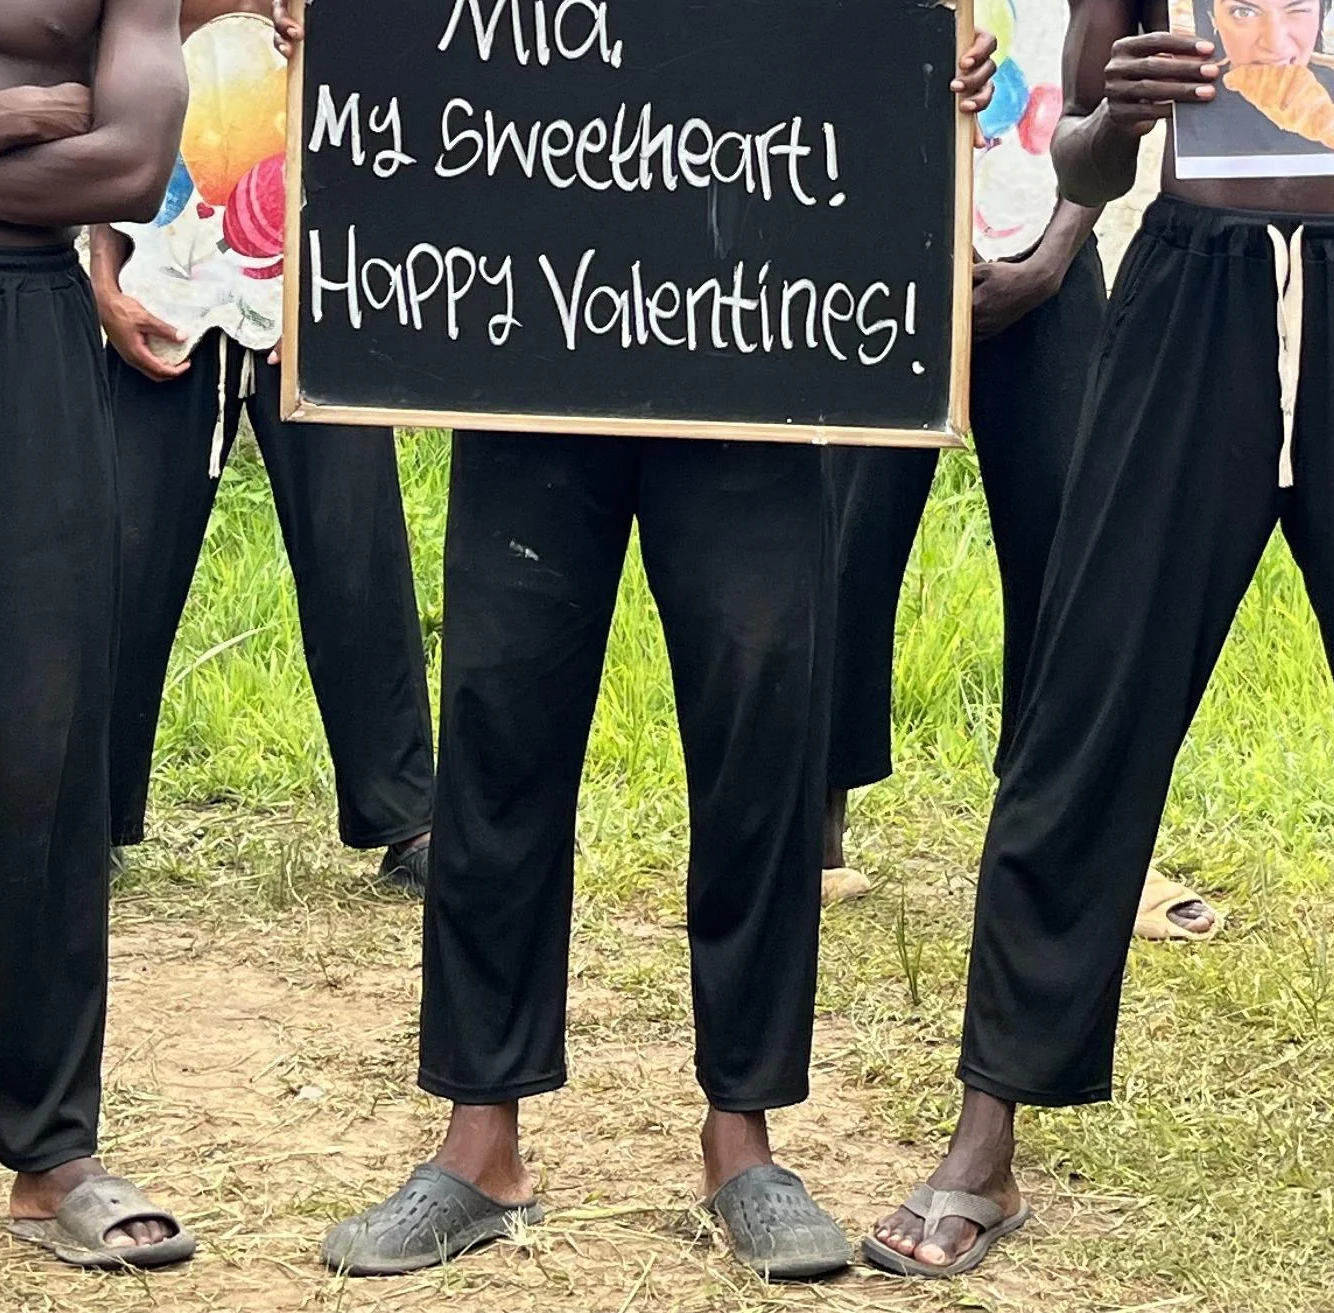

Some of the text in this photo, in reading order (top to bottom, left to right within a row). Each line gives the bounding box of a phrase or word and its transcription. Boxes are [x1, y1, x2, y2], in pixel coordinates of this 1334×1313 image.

[309, 84, 846, 207] My Sweetheart!
[308, 224, 925, 375] Happy Valentines!
